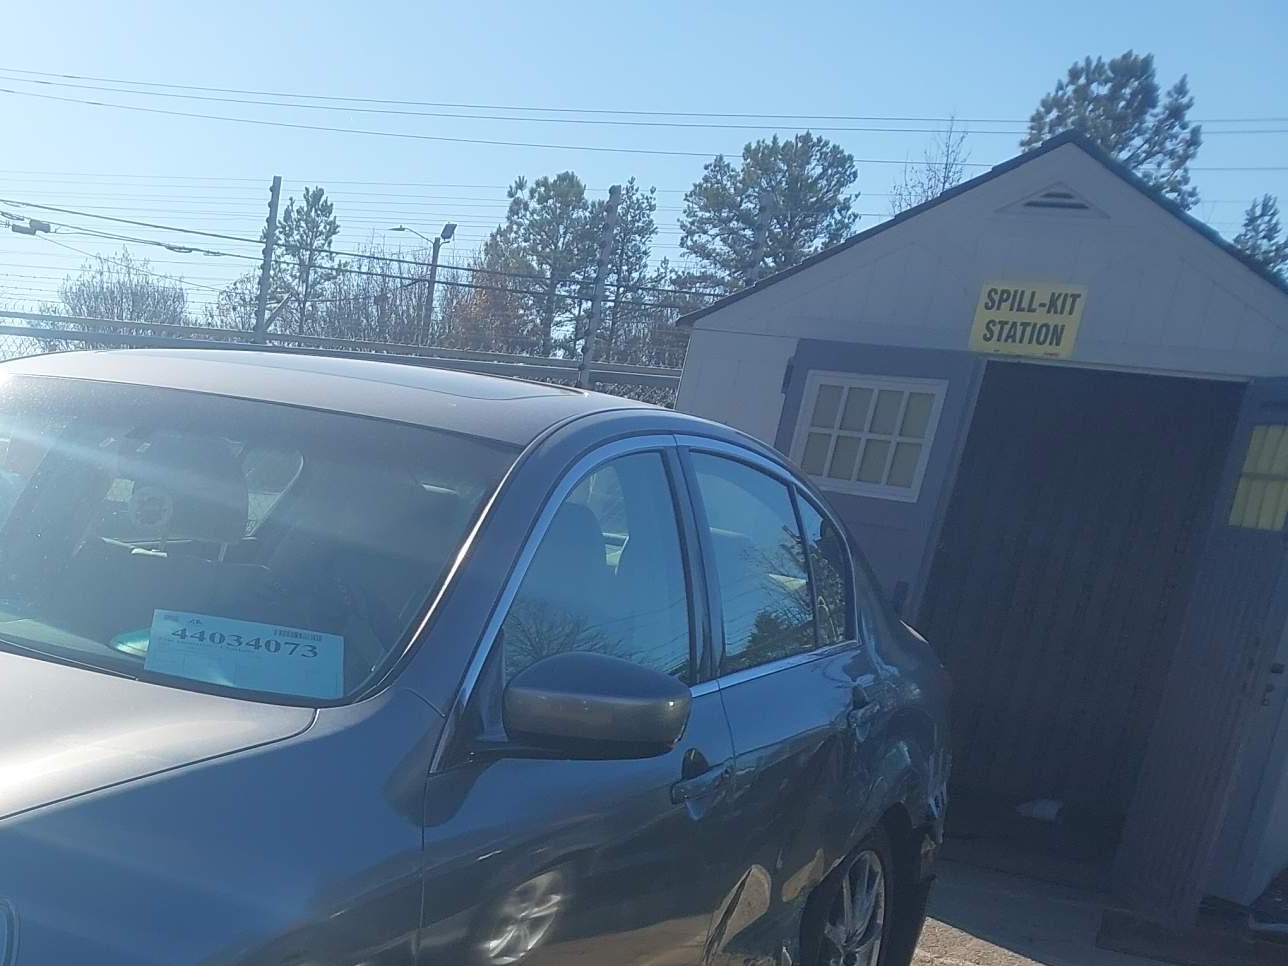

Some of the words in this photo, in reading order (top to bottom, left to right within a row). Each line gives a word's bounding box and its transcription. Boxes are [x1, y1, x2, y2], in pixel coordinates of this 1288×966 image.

[984, 288, 1082, 315] SPILL-KIT
[983, 319, 1066, 346] STATION
[171, 628, 318, 658] 44034073
